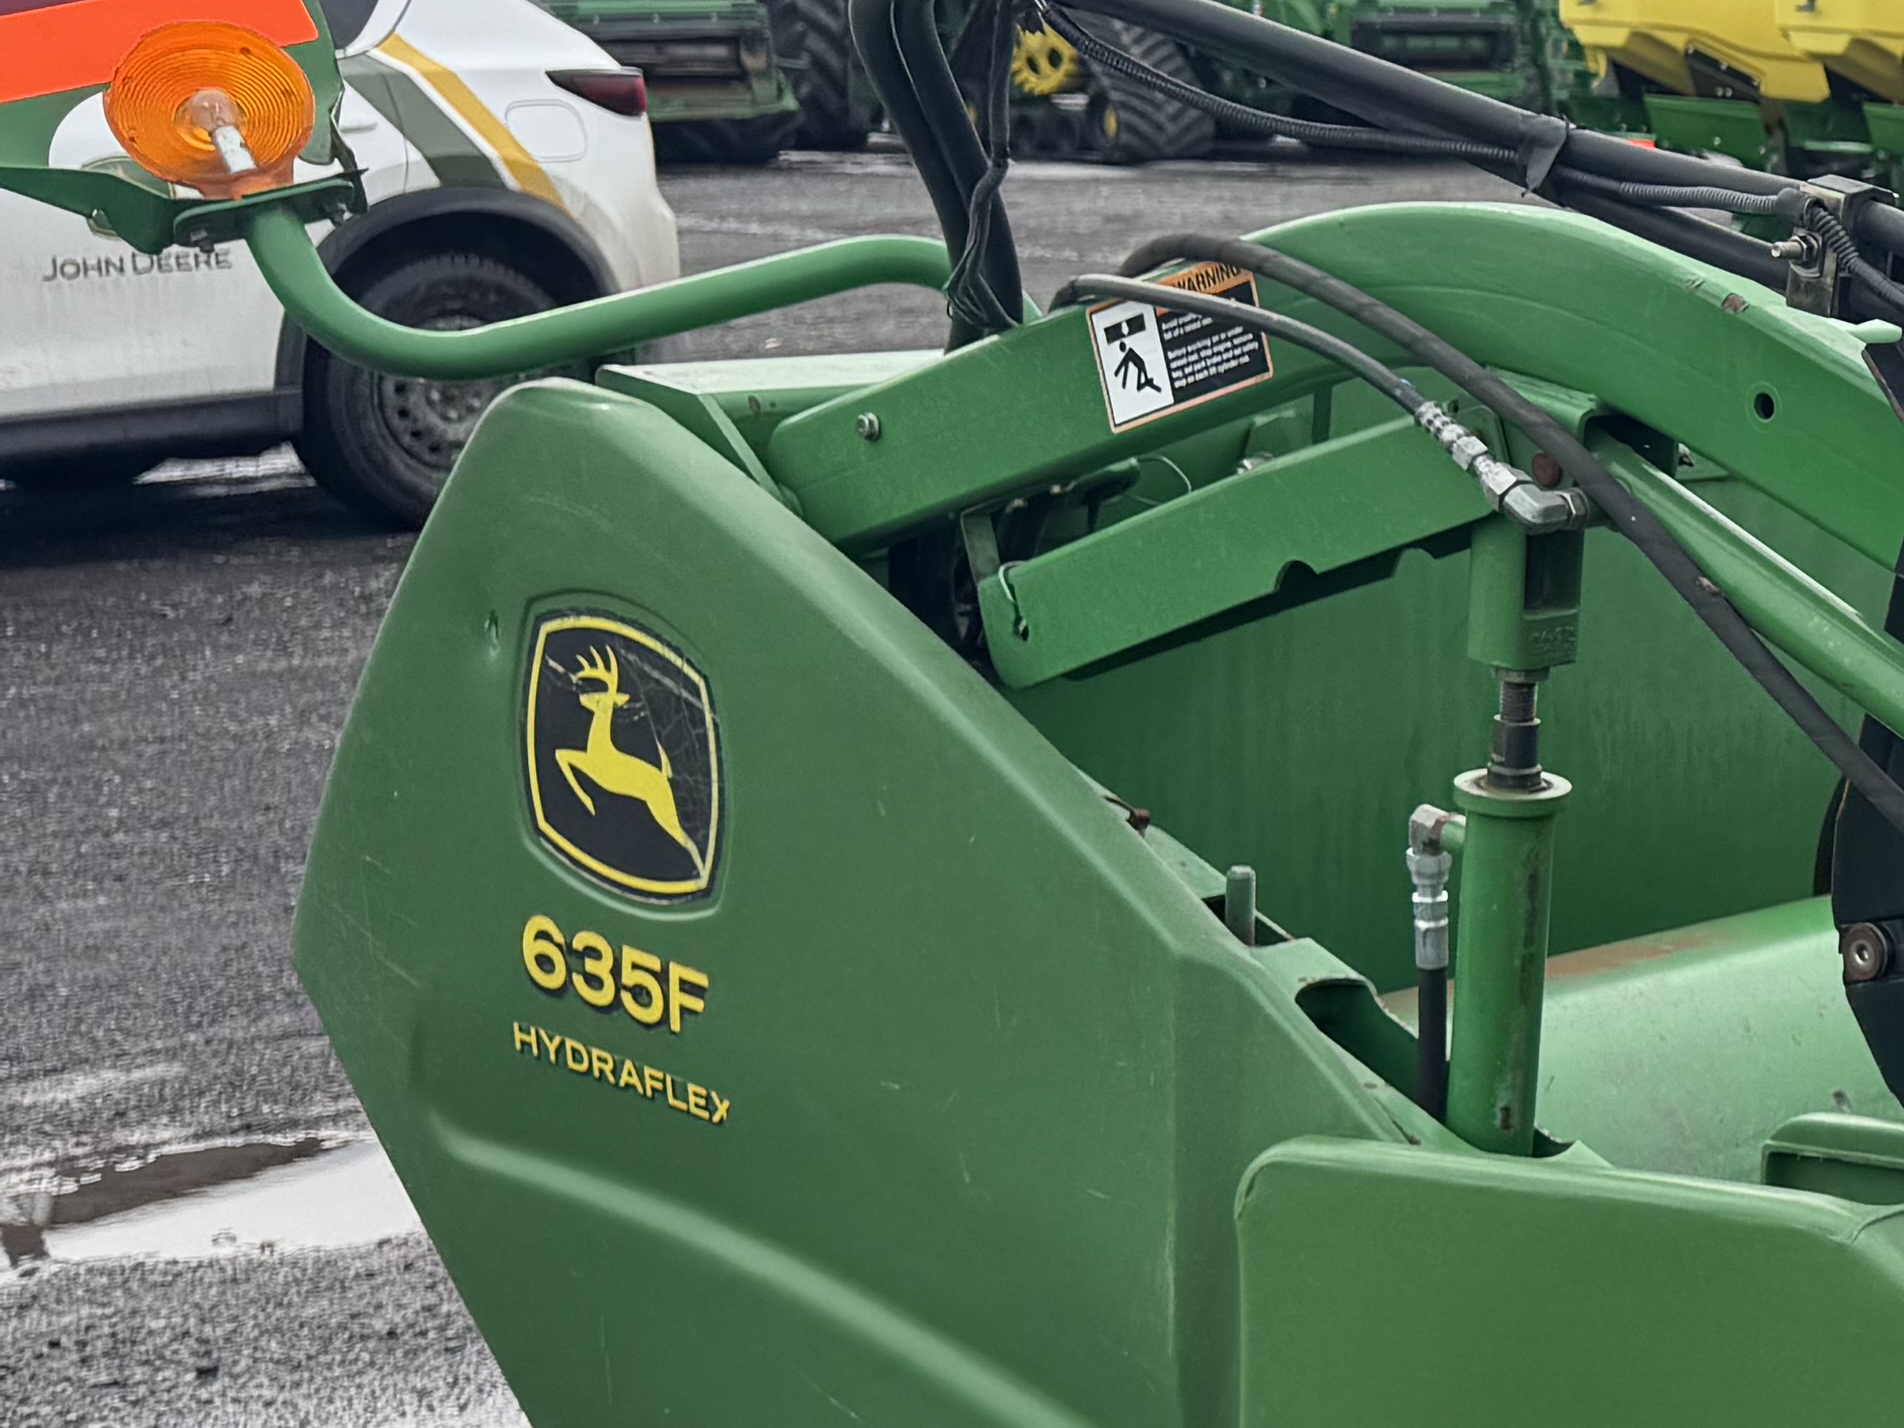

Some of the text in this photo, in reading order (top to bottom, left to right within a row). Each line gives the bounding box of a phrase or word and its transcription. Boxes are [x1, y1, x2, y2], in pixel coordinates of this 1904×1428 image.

[42, 247, 232, 282] JOHN DEERE
[521, 914, 711, 1034] 635F
[512, 1021, 732, 1125] HYDRAFLEX
